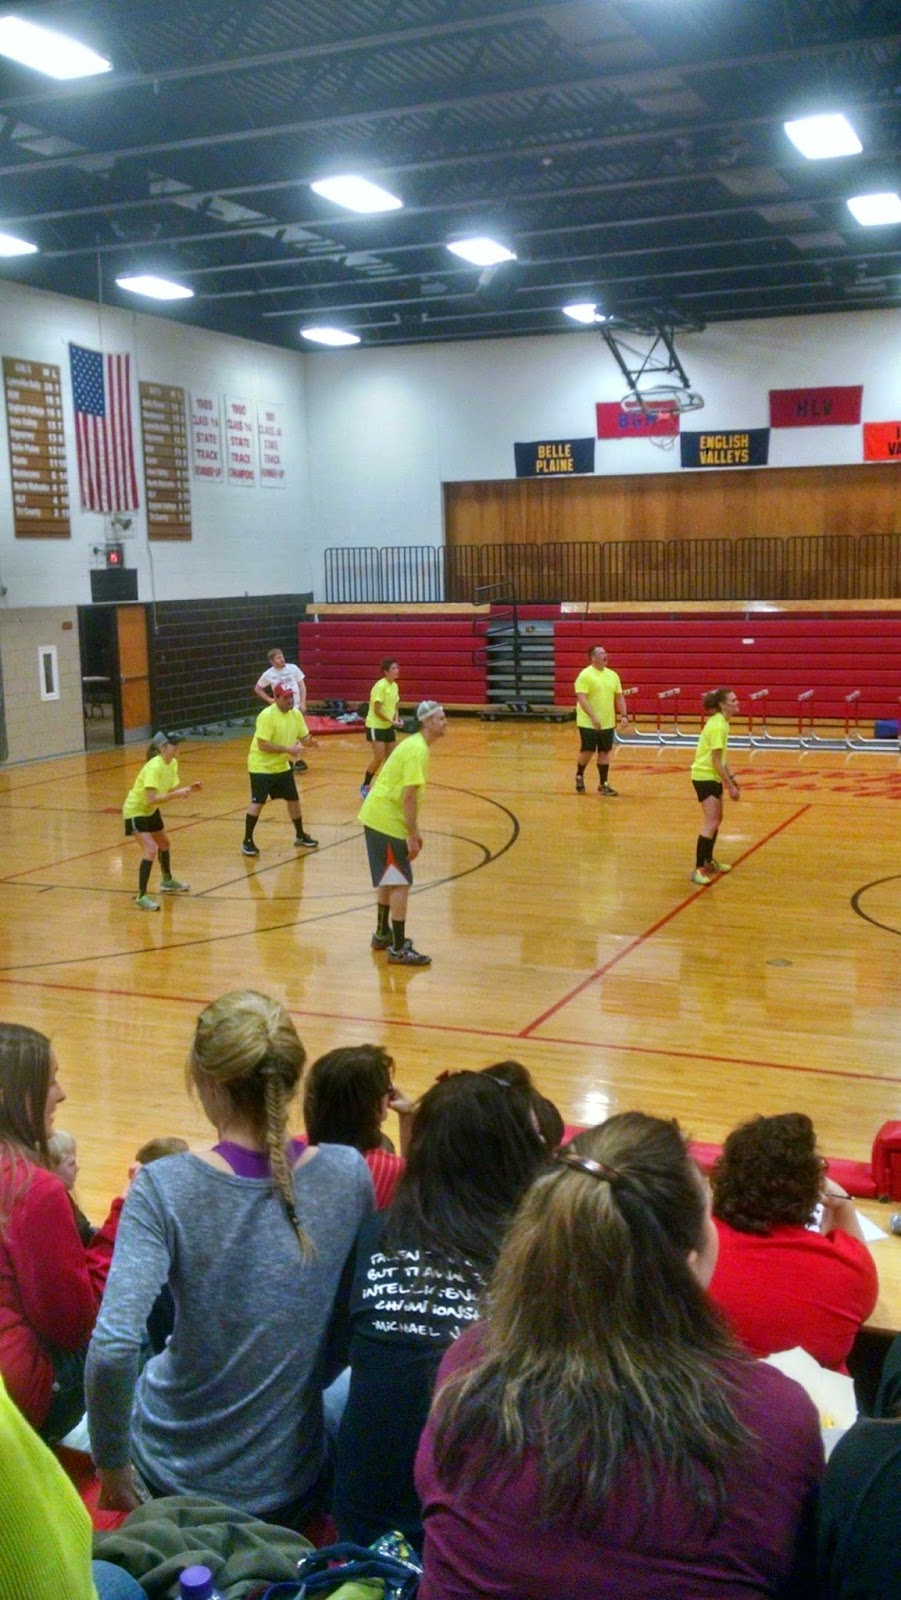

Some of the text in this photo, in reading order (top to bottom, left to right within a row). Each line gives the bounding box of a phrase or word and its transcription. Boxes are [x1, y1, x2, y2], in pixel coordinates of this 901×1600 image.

[196, 431, 217, 445] STATE
[230, 436, 250, 449] STATE
[700, 433, 749, 449] ENGLISH
[196, 448, 218, 461] TRACK
[231, 452, 251, 464] TRACK
[538, 444, 571, 458] BELLE
[700, 449, 749, 465] VALLEYS
[536, 459, 574, 473] PLAINE
[367, 1267, 399, 1281] BUT
